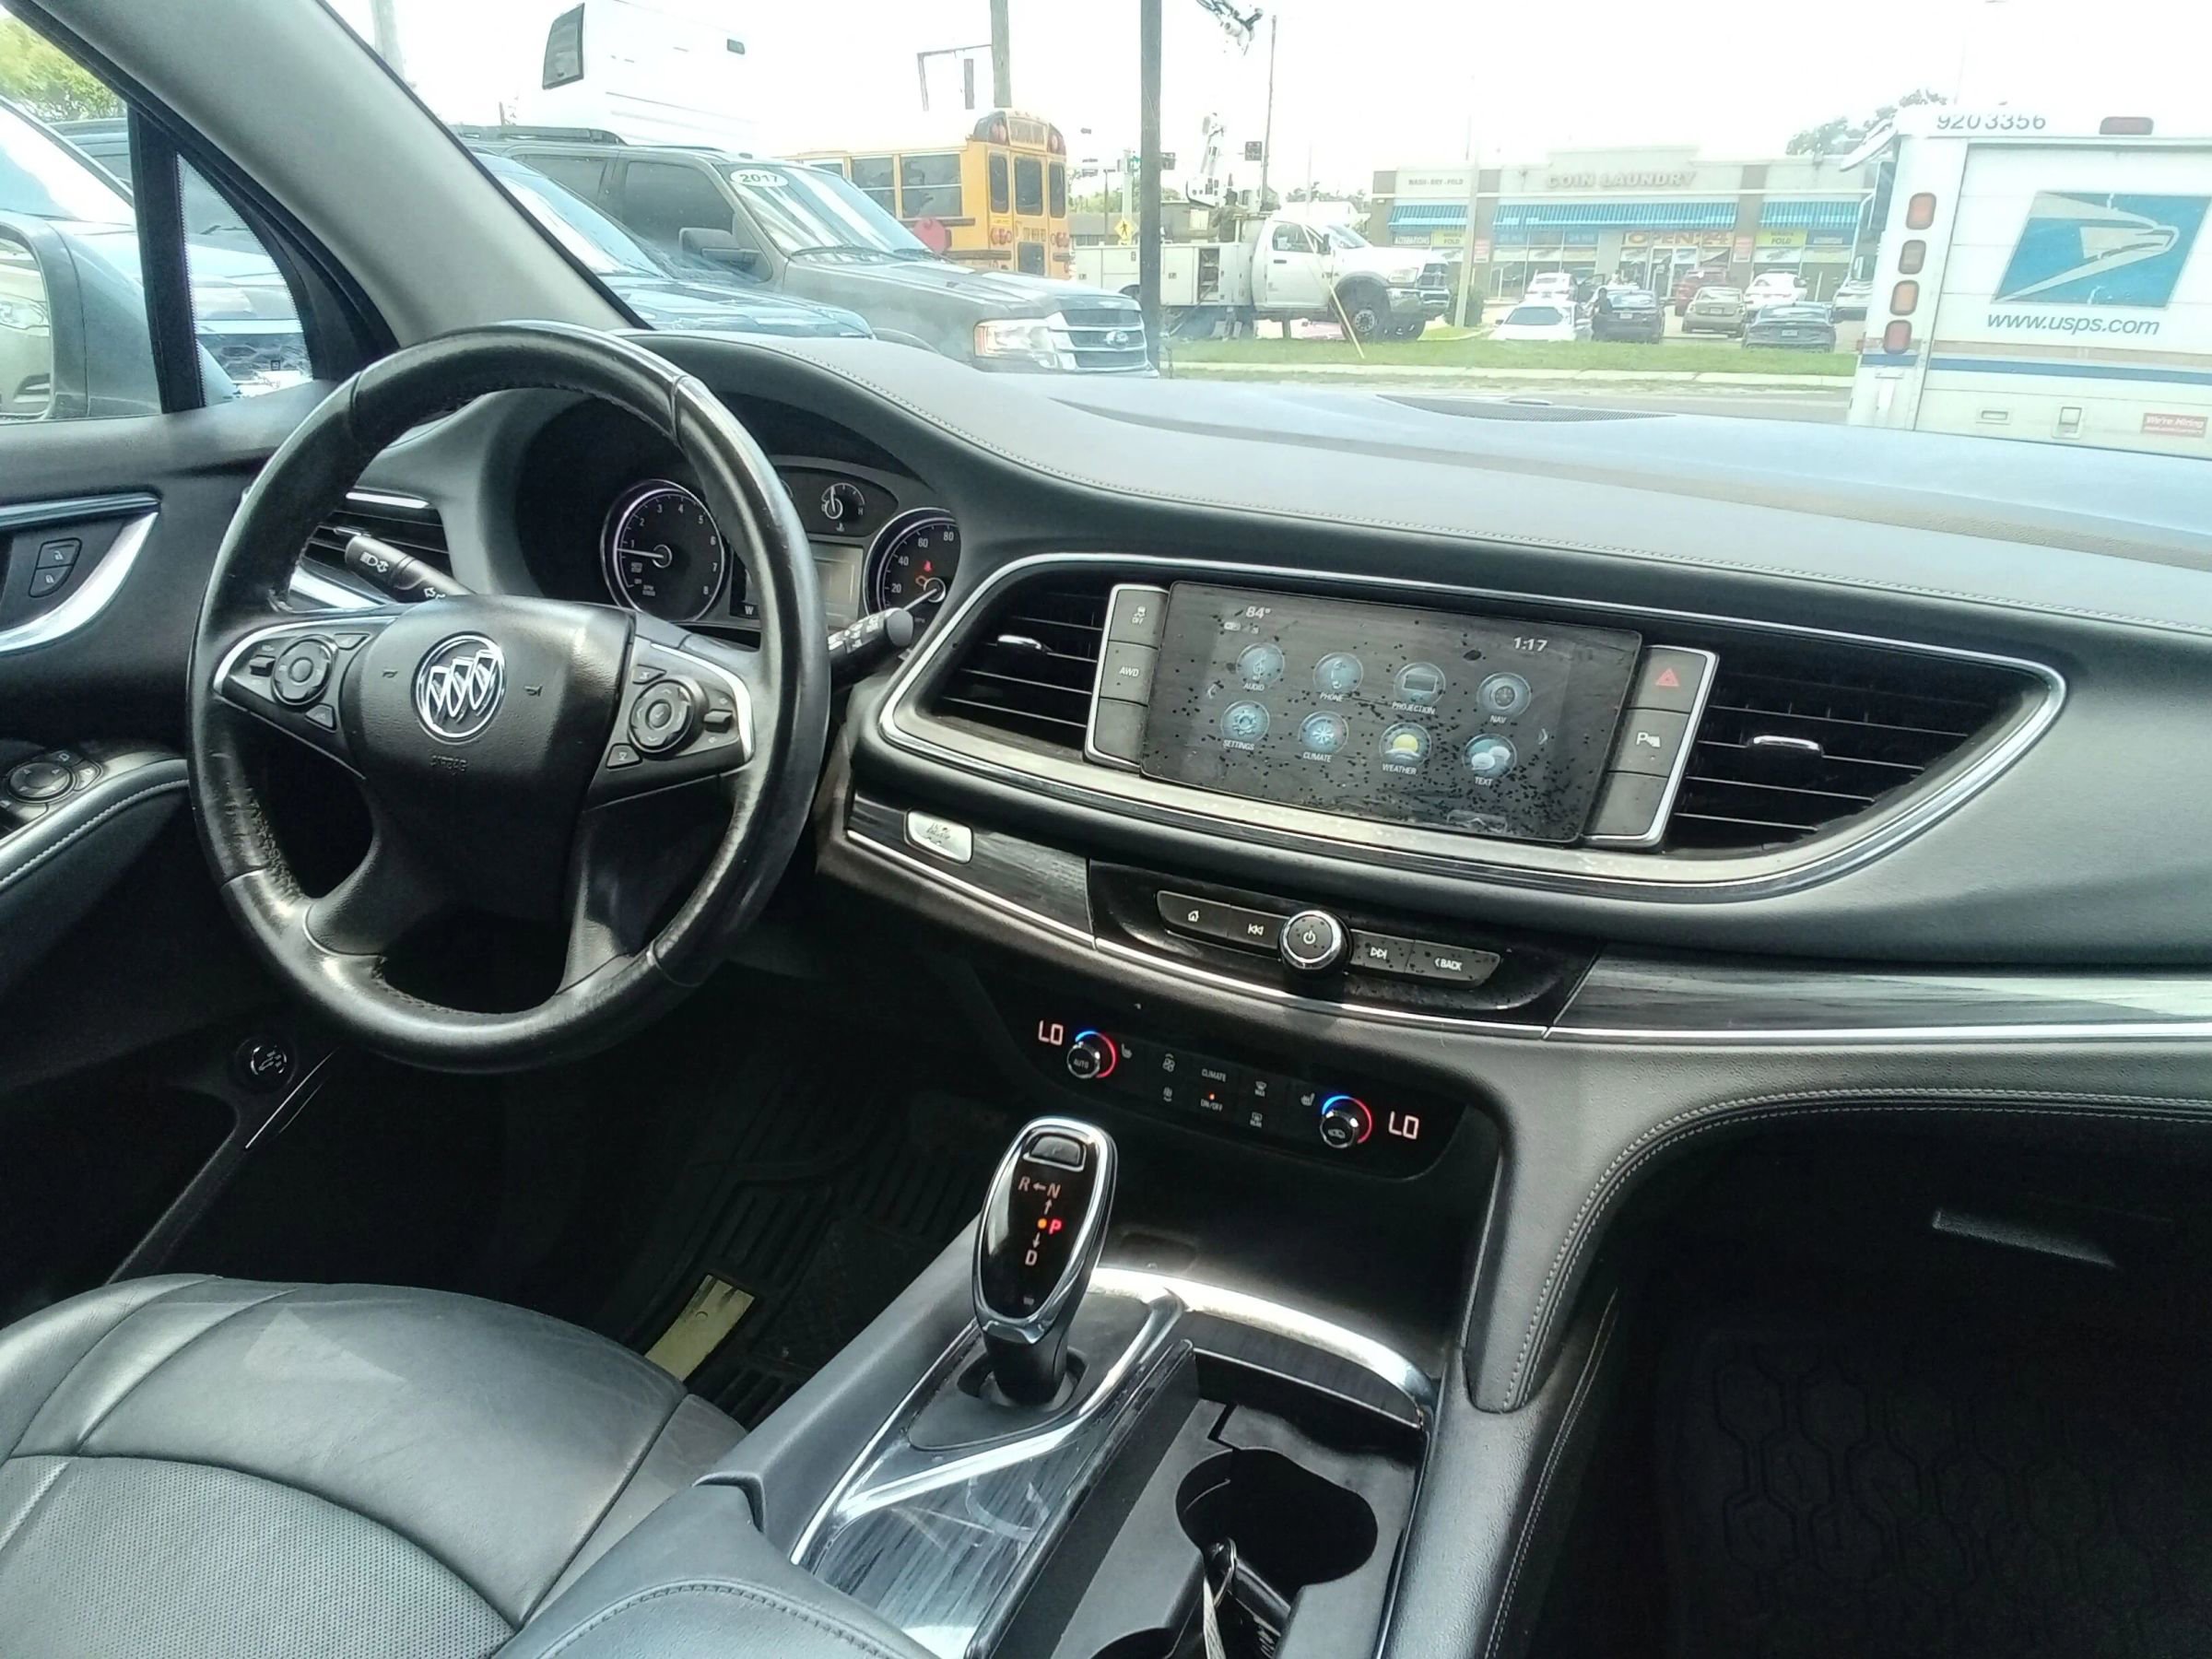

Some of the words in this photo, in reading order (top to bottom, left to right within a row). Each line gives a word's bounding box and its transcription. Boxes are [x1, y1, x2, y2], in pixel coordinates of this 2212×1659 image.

[739, 173, 778, 182] 2017
[1547, 173, 1596, 188] COIN
[1599, 171, 1697, 188] LAUNDRY
[1987, 314, 2159, 335] www.usps.com
[918, 538, 929, 547] 60
[943, 532, 955, 542] 80
[898, 557, 909, 566] 40
[891, 583, 902, 594] 20
[745, 606, 754, 615] W
[1245, 606, 1271, 618] 84°
[1513, 637, 1548, 652] 1:17
[1119, 666, 1139, 677] AWD
[1243, 683, 1265, 691] AUDIO
[1320, 692, 1343, 701] PHONE
[1392, 701, 1436, 714] PROJECTION
[1489, 715, 1507, 724] NAV
[1223, 740, 1254, 750] SETTINGS
[1303, 751, 1332, 762] CLIMATE
[1382, 763, 1417, 774] WEATHER
[1475, 777, 1493, 785] TEXT
[1441, 959, 1463, 971] BACK
[1038, 1020, 1064, 1045] LO
[1073, 1058, 1089, 1069] AUTO
[1201, 1069, 1227, 1082] CLIMATE
[1388, 1111, 1419, 1139] LO
[1018, 1176, 1030, 1192] R
[1047, 1183, 1061, 1199] N
[1049, 1218, 1062, 1234] P
[1025, 1250, 1038, 1265] D
